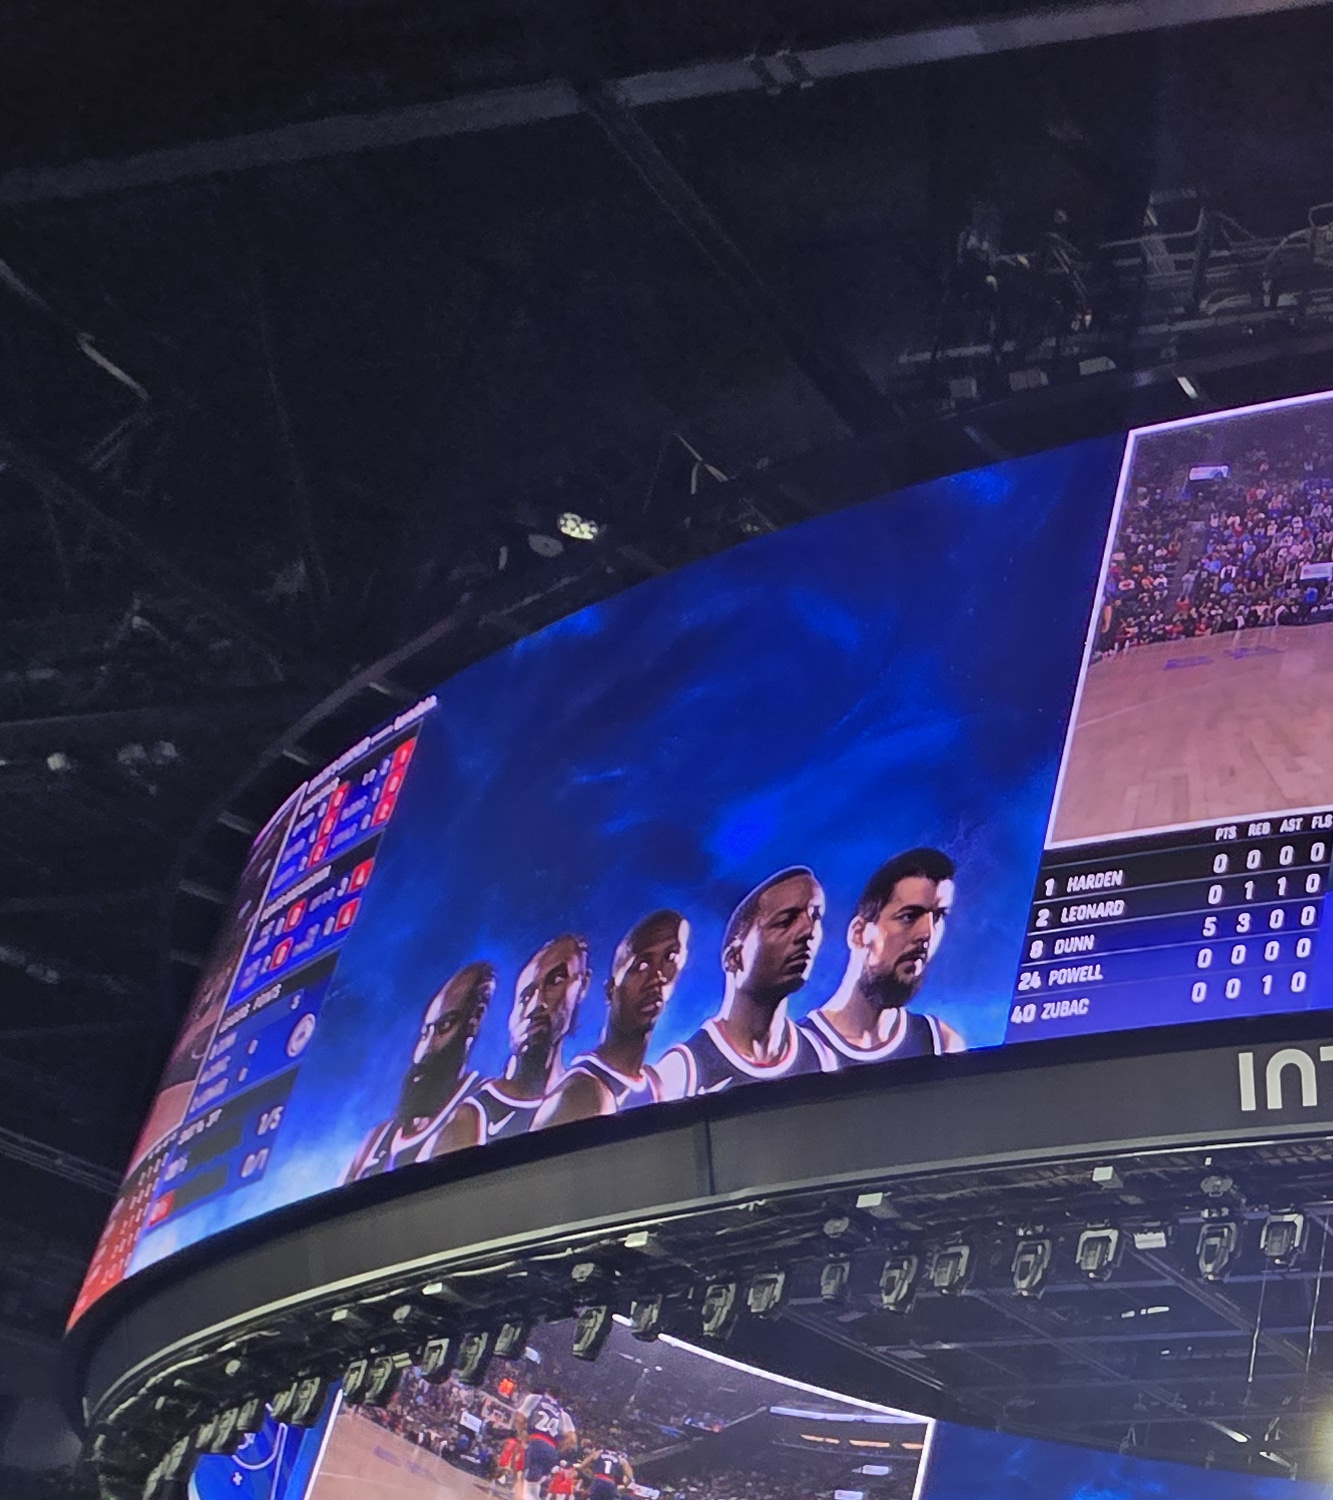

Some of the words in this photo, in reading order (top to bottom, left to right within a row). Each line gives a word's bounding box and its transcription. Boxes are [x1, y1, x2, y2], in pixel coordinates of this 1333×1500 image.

[1045, 879, 1054, 896] 1
[1067, 871, 1123, 893] HARDEN
[1036, 909, 1049, 927] 2
[1061, 900, 1124, 922] LEONARD
[1030, 941, 1043, 959] 8
[1055, 935, 1095, 955] DUNN
[1018, 971, 1041, 991] 24
[1048, 964, 1103, 987] POWELL
[1011, 1004, 1035, 1024] 40
[1041, 998, 1089, 1020] ZUBAC
